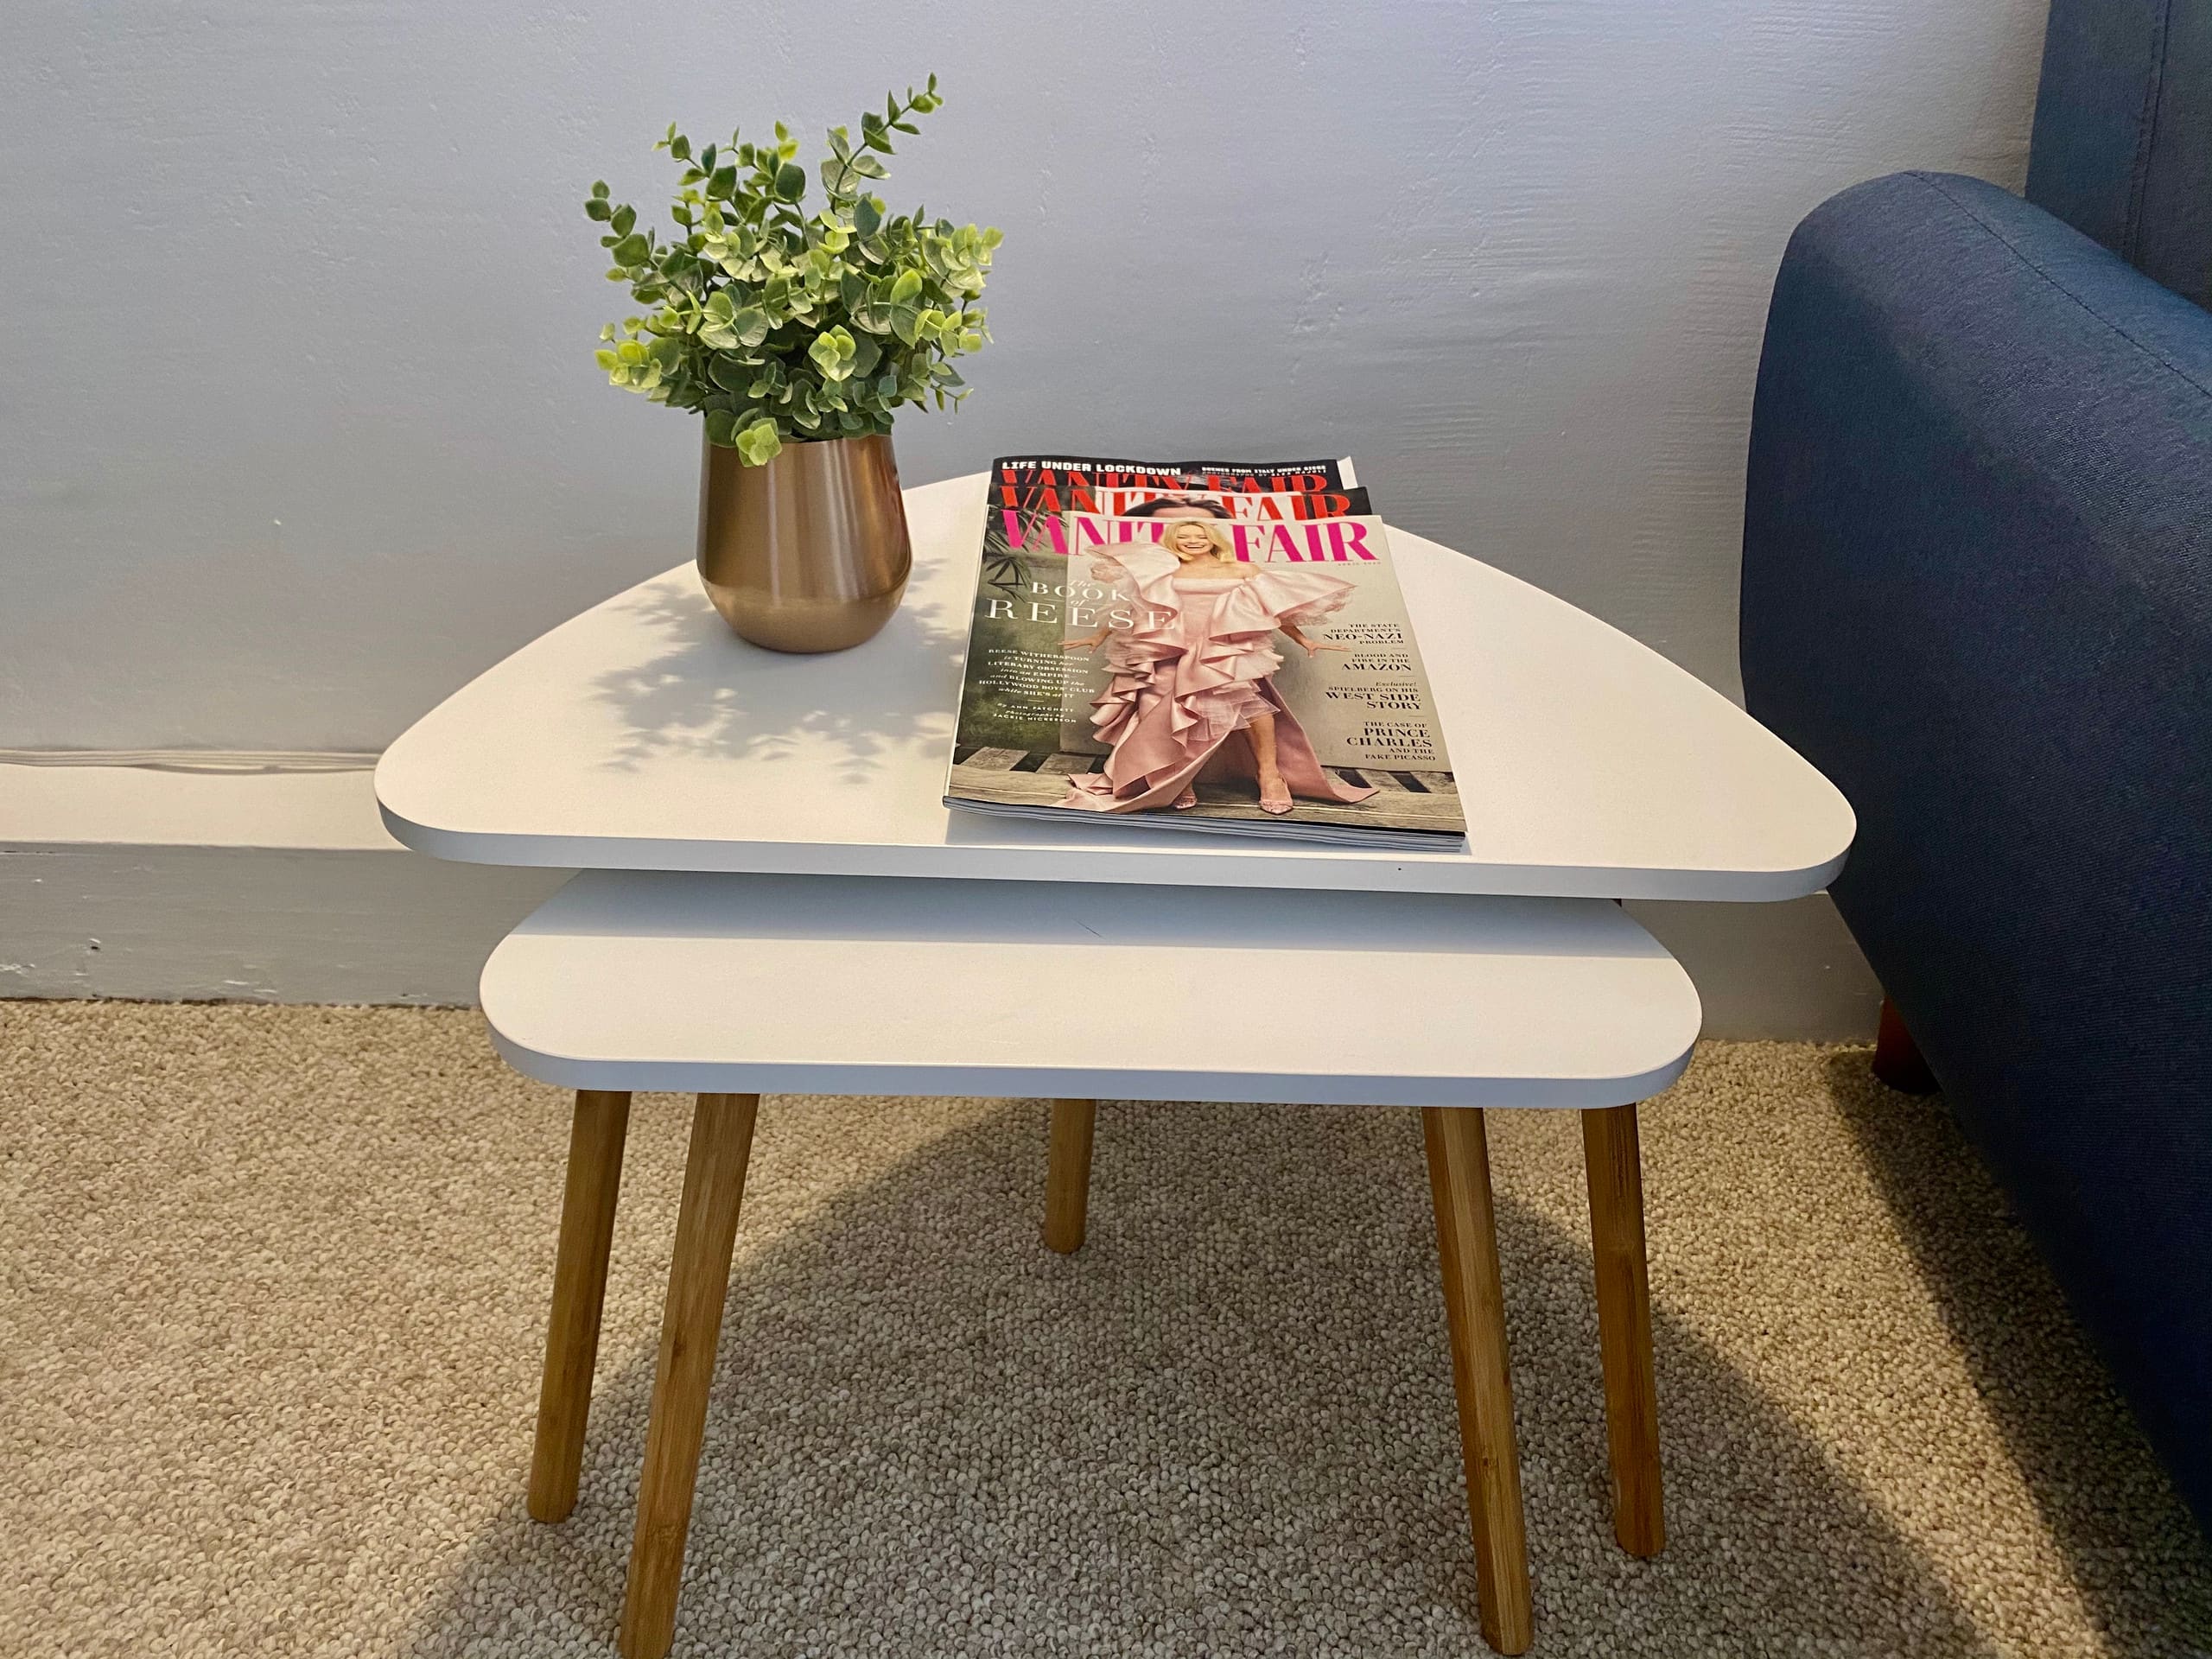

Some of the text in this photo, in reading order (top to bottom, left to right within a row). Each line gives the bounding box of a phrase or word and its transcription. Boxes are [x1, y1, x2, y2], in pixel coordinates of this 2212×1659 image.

[1001, 461, 1181, 475] LIFE UNDER LOCKDOWN
[1001, 509, 1380, 563] VANIT FAIR
[1030, 582, 1131, 601] BOOK
[1070, 598, 1090, 607] of
[984, 598, 1176, 631] REESE
[1014, 656, 1057, 665] TURNING
[1020, 651, 1090, 662] WITHERSPOON
[988, 661, 1089, 674] LITERARY OBSESSION
[1341, 663, 1412, 671] AMAZON
[979, 679, 1039, 690] HOLLYWOOD
[1009, 675, 1054, 684] BLOWING
[1325, 691, 1421, 702] WEST SIDE
[1366, 701, 1421, 710] STORY
[1363, 728, 1431, 738] PRINCE
[1346, 737, 1433, 747] CHARLES
